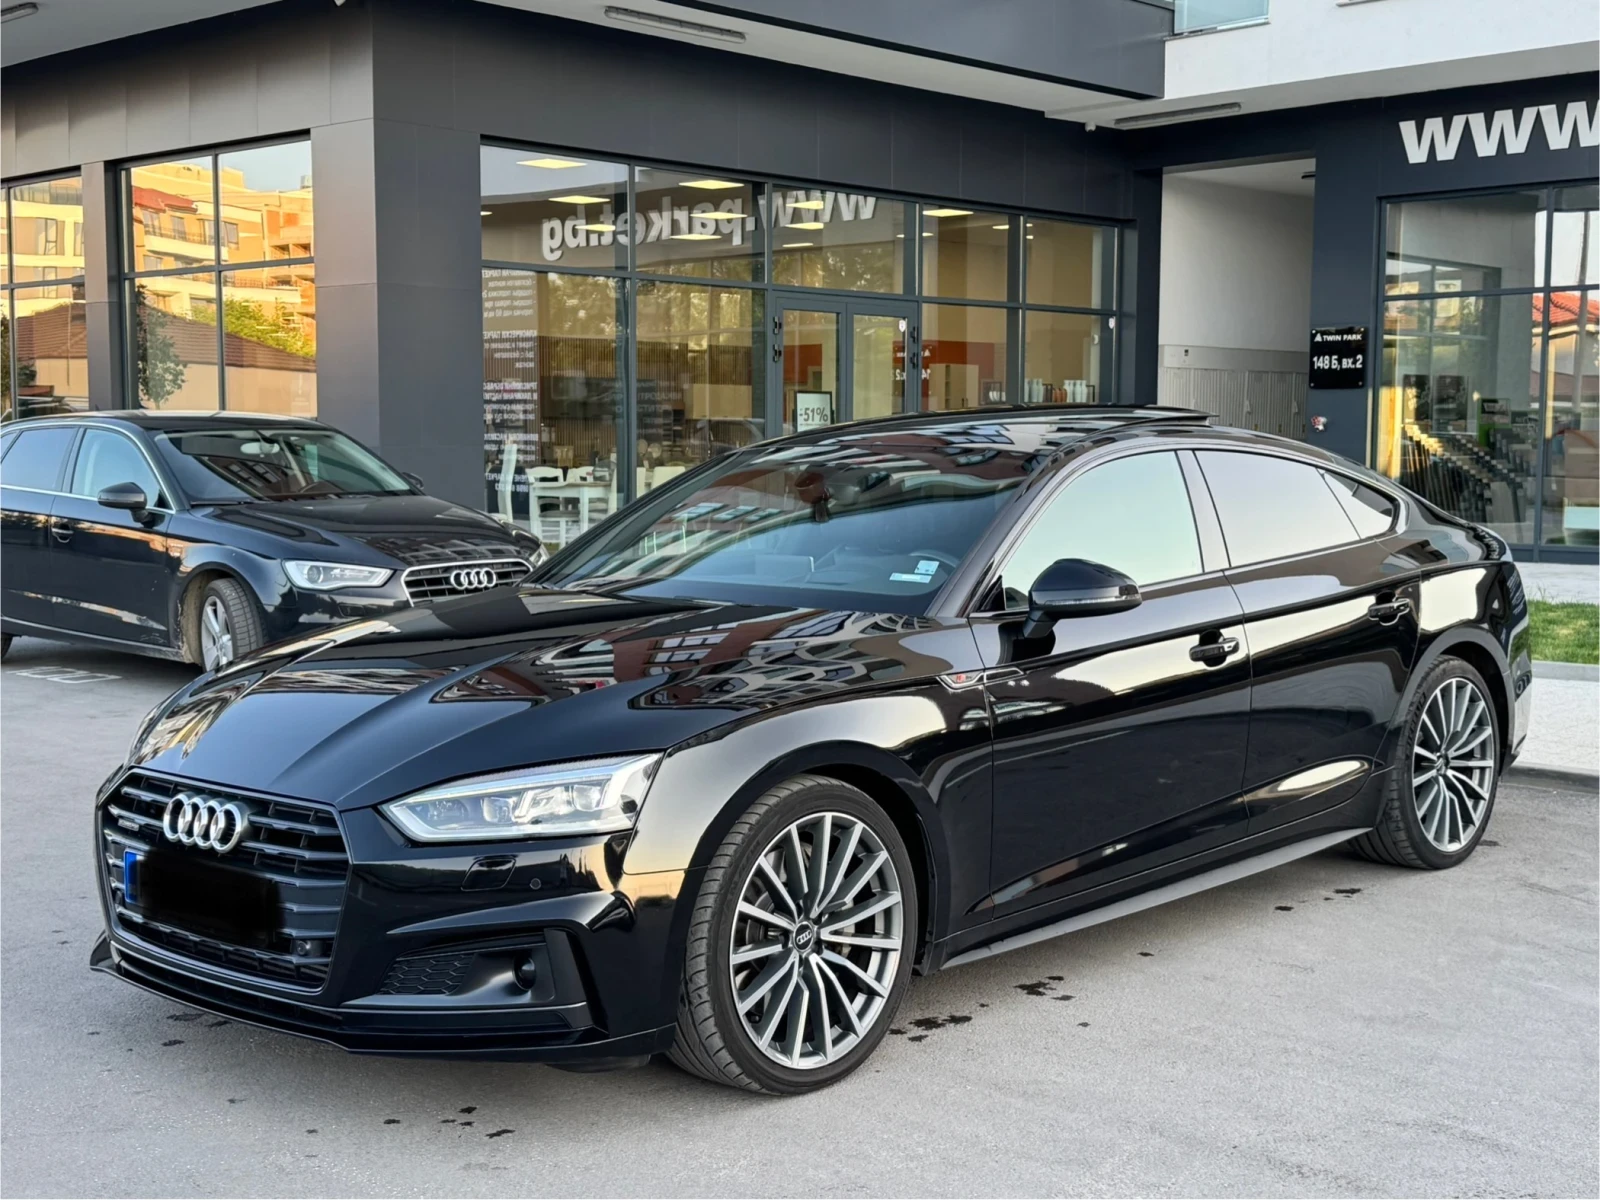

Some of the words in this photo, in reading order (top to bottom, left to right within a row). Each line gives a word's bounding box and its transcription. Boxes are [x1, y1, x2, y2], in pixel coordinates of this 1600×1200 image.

[1398, 101, 1600, 164] www
[1322, 334, 1342, 342] TWIN
[1343, 333, 1363, 341] PARK
[1312, 355, 1330, 370] 148
